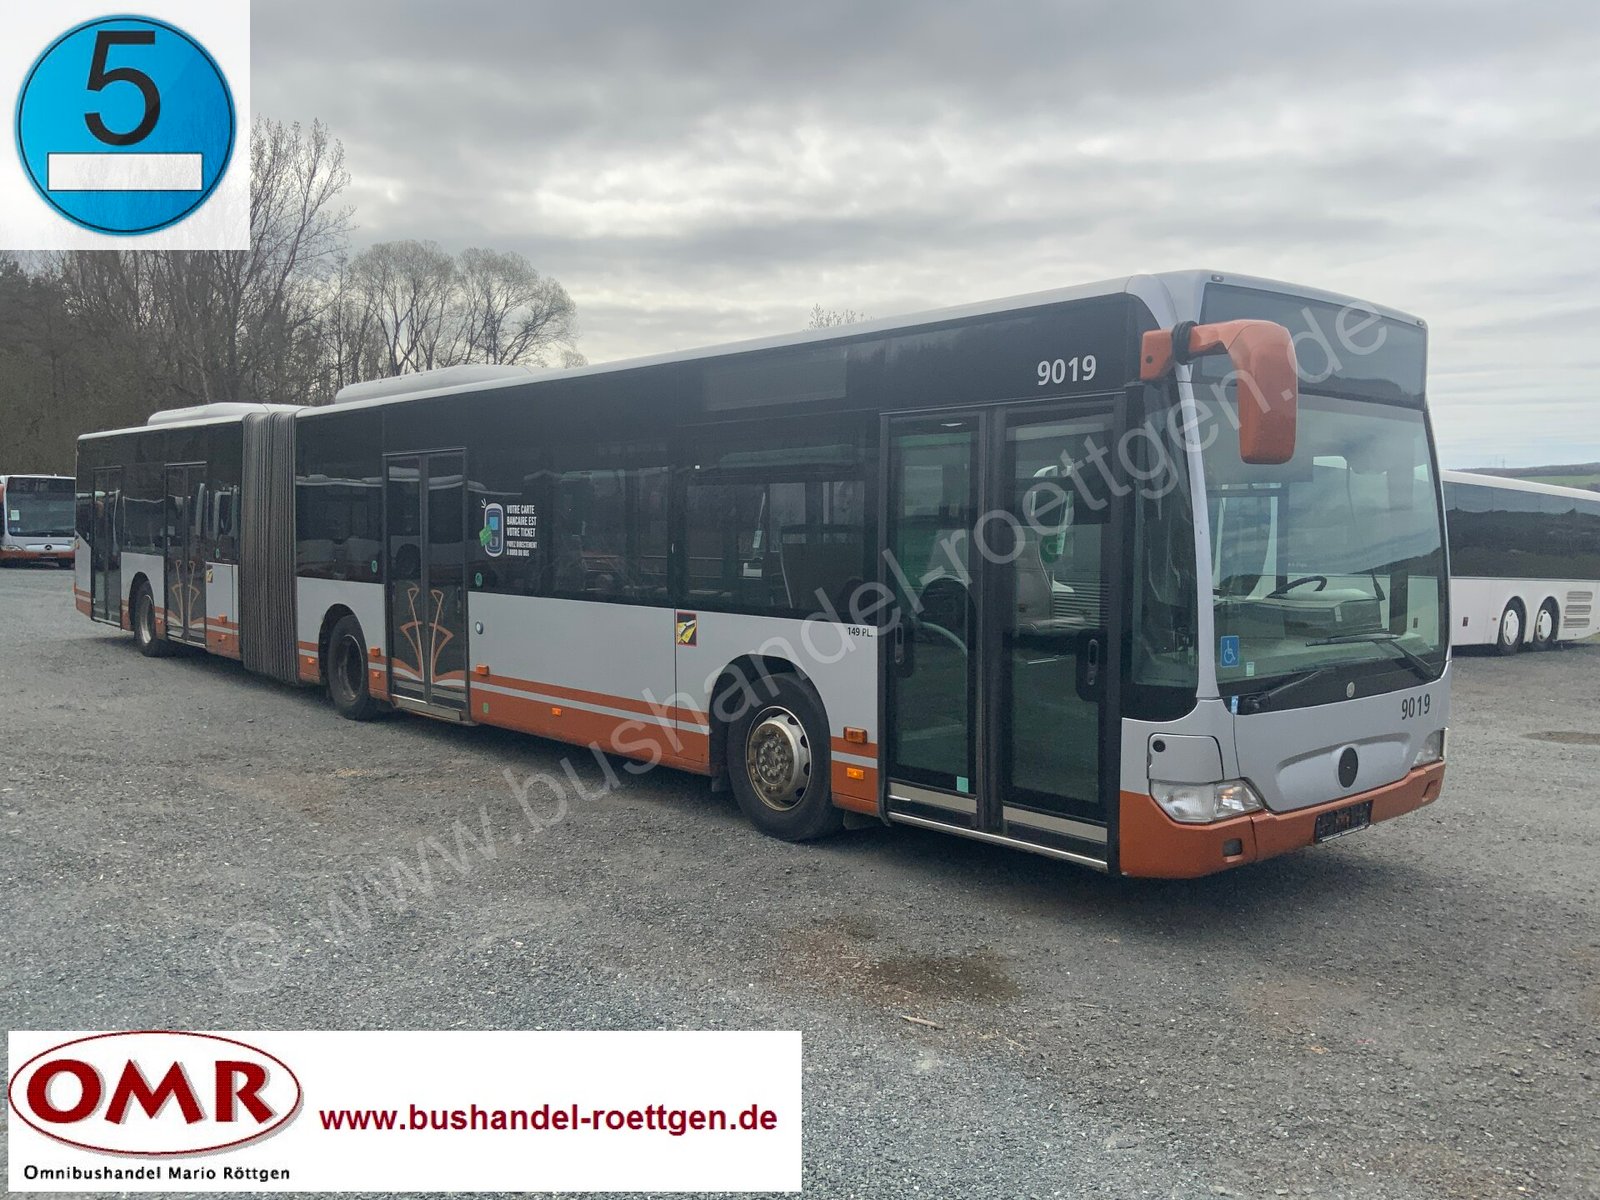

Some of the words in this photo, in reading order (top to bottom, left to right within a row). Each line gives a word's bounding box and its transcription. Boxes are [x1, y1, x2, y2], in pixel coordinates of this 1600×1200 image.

[1037, 355, 1097, 386] 9019
[506, 505, 520, 514] VOTRE
[520, 505, 535, 514] CARTE
[506, 516, 528, 526] BANCAIRE
[528, 516, 537, 526] EST
[506, 528, 520, 536] VOTRE
[520, 528, 536, 537] TICKET
[848, 627, 860, 636] 149
[1401, 693, 1431, 720] 9019
